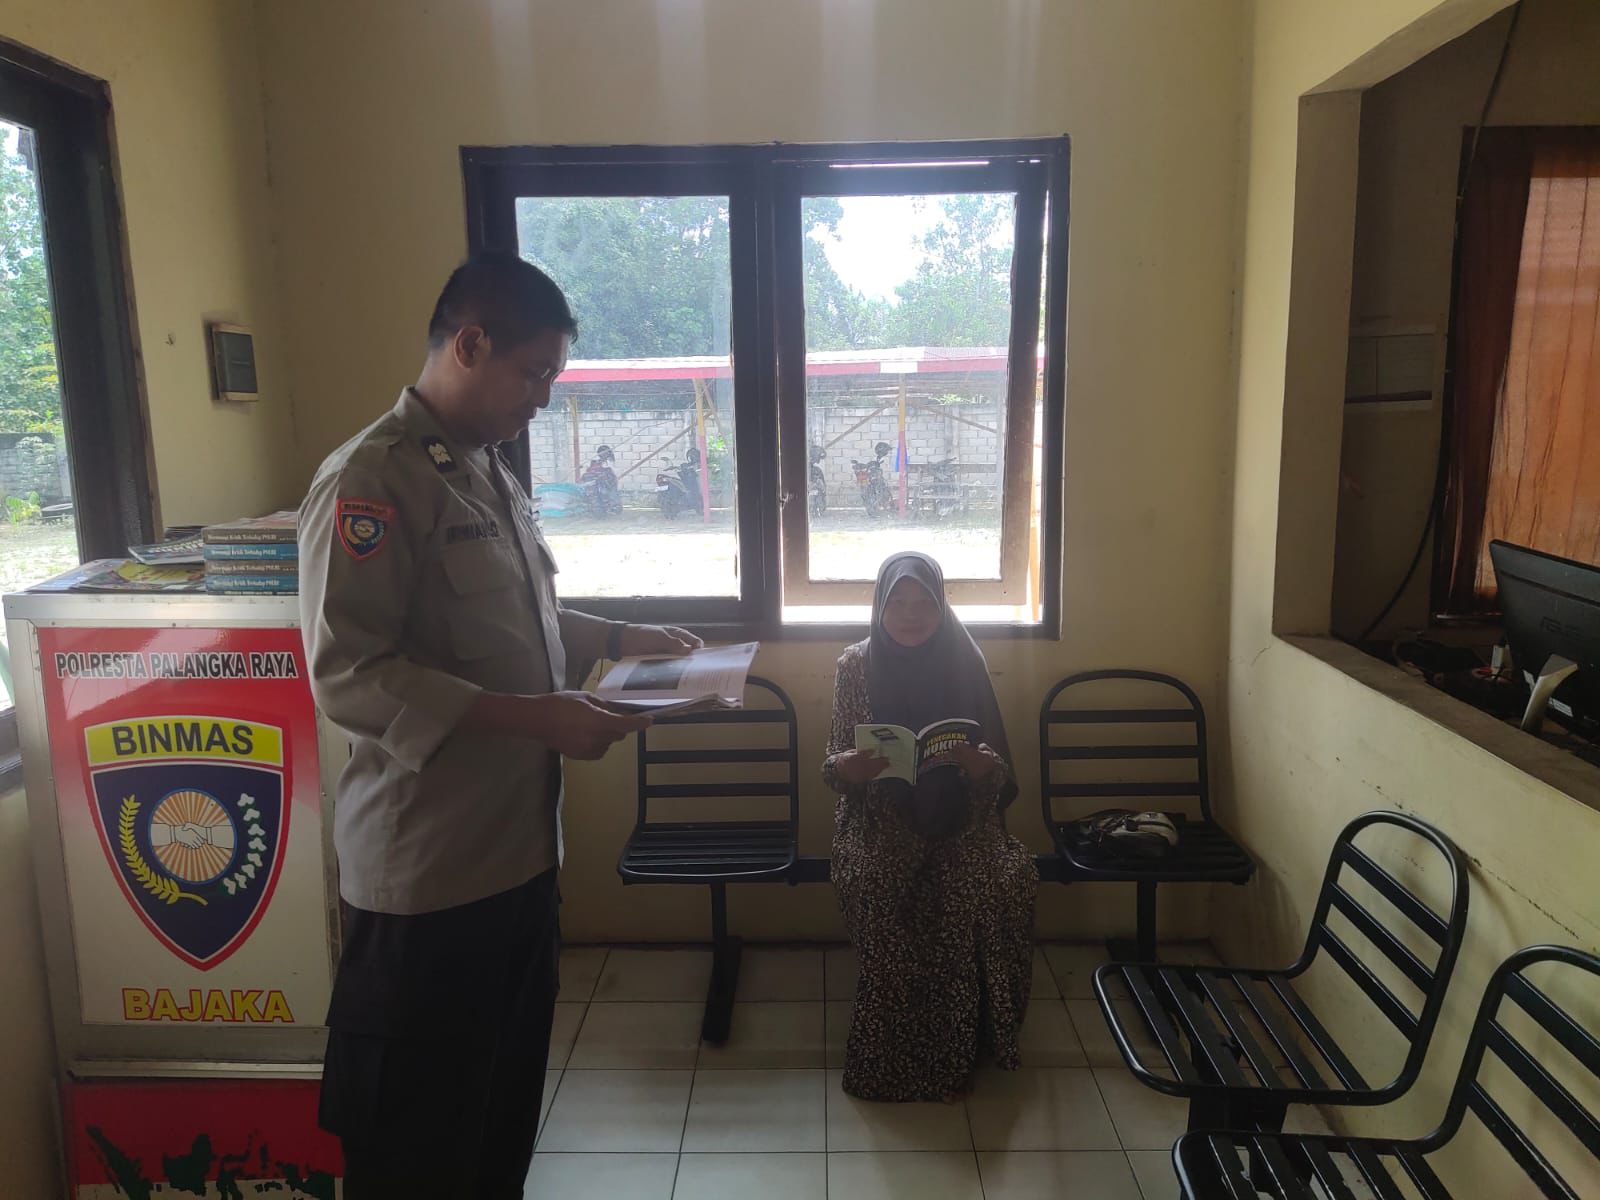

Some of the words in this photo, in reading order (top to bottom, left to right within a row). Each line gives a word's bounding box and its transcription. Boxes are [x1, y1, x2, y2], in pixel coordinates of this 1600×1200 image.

[55, 652, 147, 679] POLRESTA
[151, 652, 249, 679] PALANGKA
[251, 652, 298, 679] RAYA
[112, 722, 254, 756] BINMAS
[923, 739, 967, 760] HUKU
[122, 988, 295, 1022] BAJAKA
